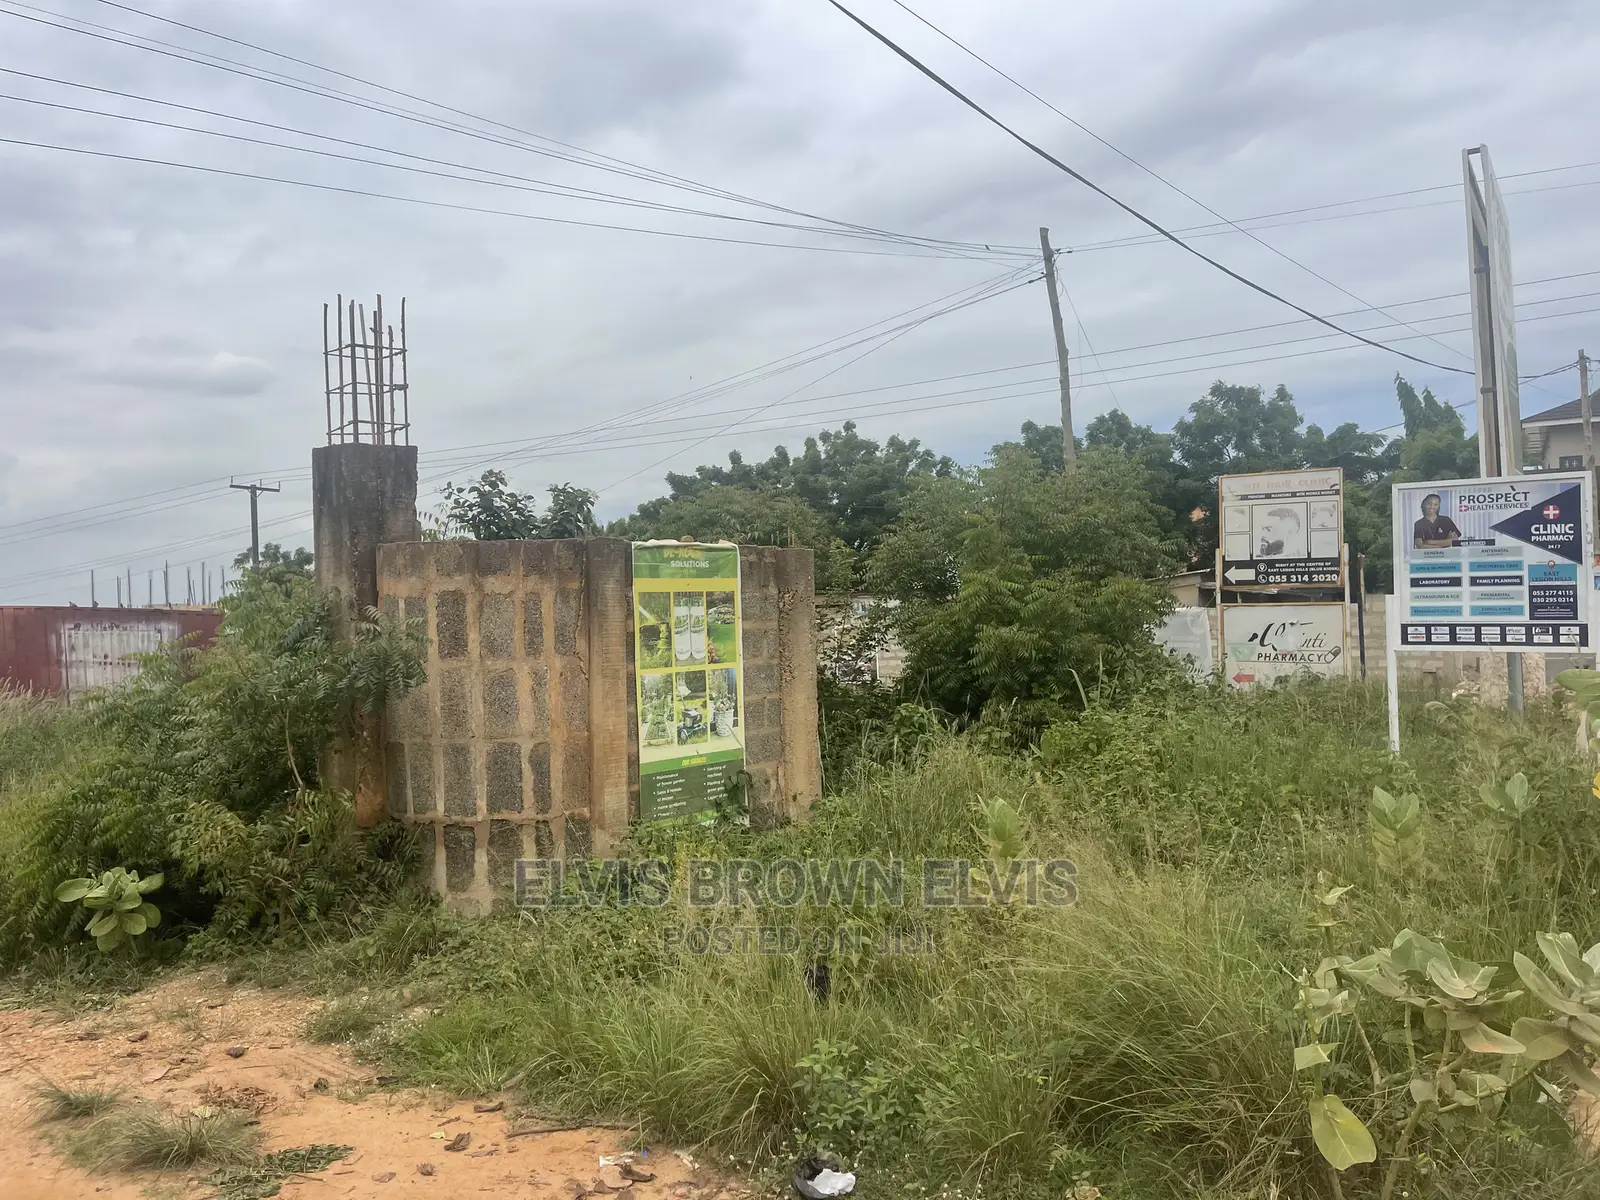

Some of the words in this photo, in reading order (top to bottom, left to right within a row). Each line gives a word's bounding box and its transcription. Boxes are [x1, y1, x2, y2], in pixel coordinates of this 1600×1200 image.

[1459, 491, 1530, 504] PROSPECT
[1468, 503, 1494, 512] HEALTH
[1495, 502, 1529, 511] SERVICES
[1531, 523, 1574, 535] CLINIC
[1531, 534, 1574, 542] PHARMACY
[670, 560, 710, 568] SOLUTIONS
[1268, 574, 1287, 583] 055
[1290, 574, 1310, 582] 314
[1312, 573, 1338, 582] 2020
[1257, 652, 1323, 662] PHARMACY
